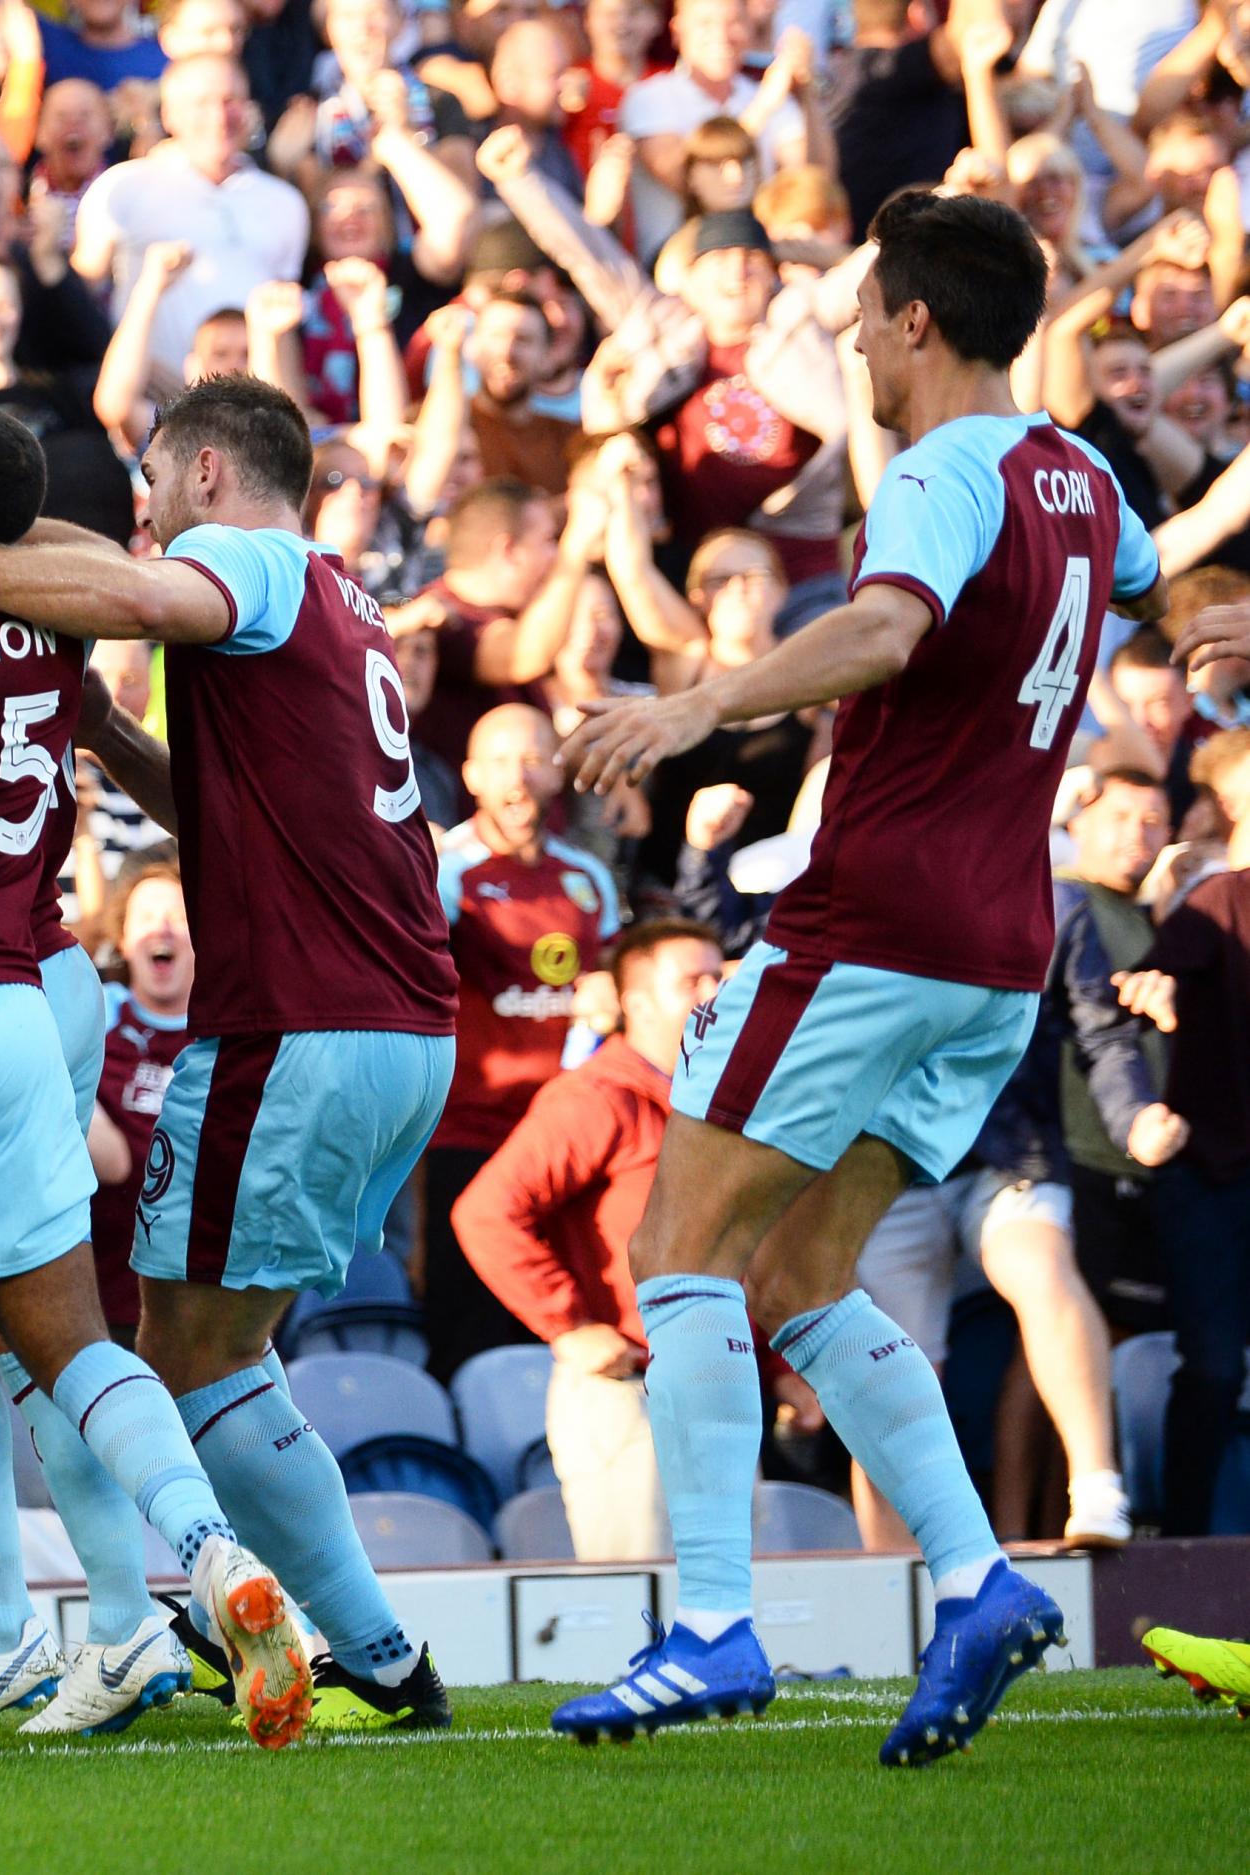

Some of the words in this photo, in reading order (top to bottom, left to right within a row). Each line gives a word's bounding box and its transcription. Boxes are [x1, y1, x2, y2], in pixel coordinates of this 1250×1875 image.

[1034, 470, 1095, 515] CORK
[331, 568, 386, 633] VOKE
[1017, 557, 1091, 750] 4
[365, 648, 422, 823] 9
[141, 1127, 175, 1205] 9
[726, 1337, 756, 1353] BF
[868, 1337, 916, 1362] BFC
[273, 1423, 314, 1453] BFC
